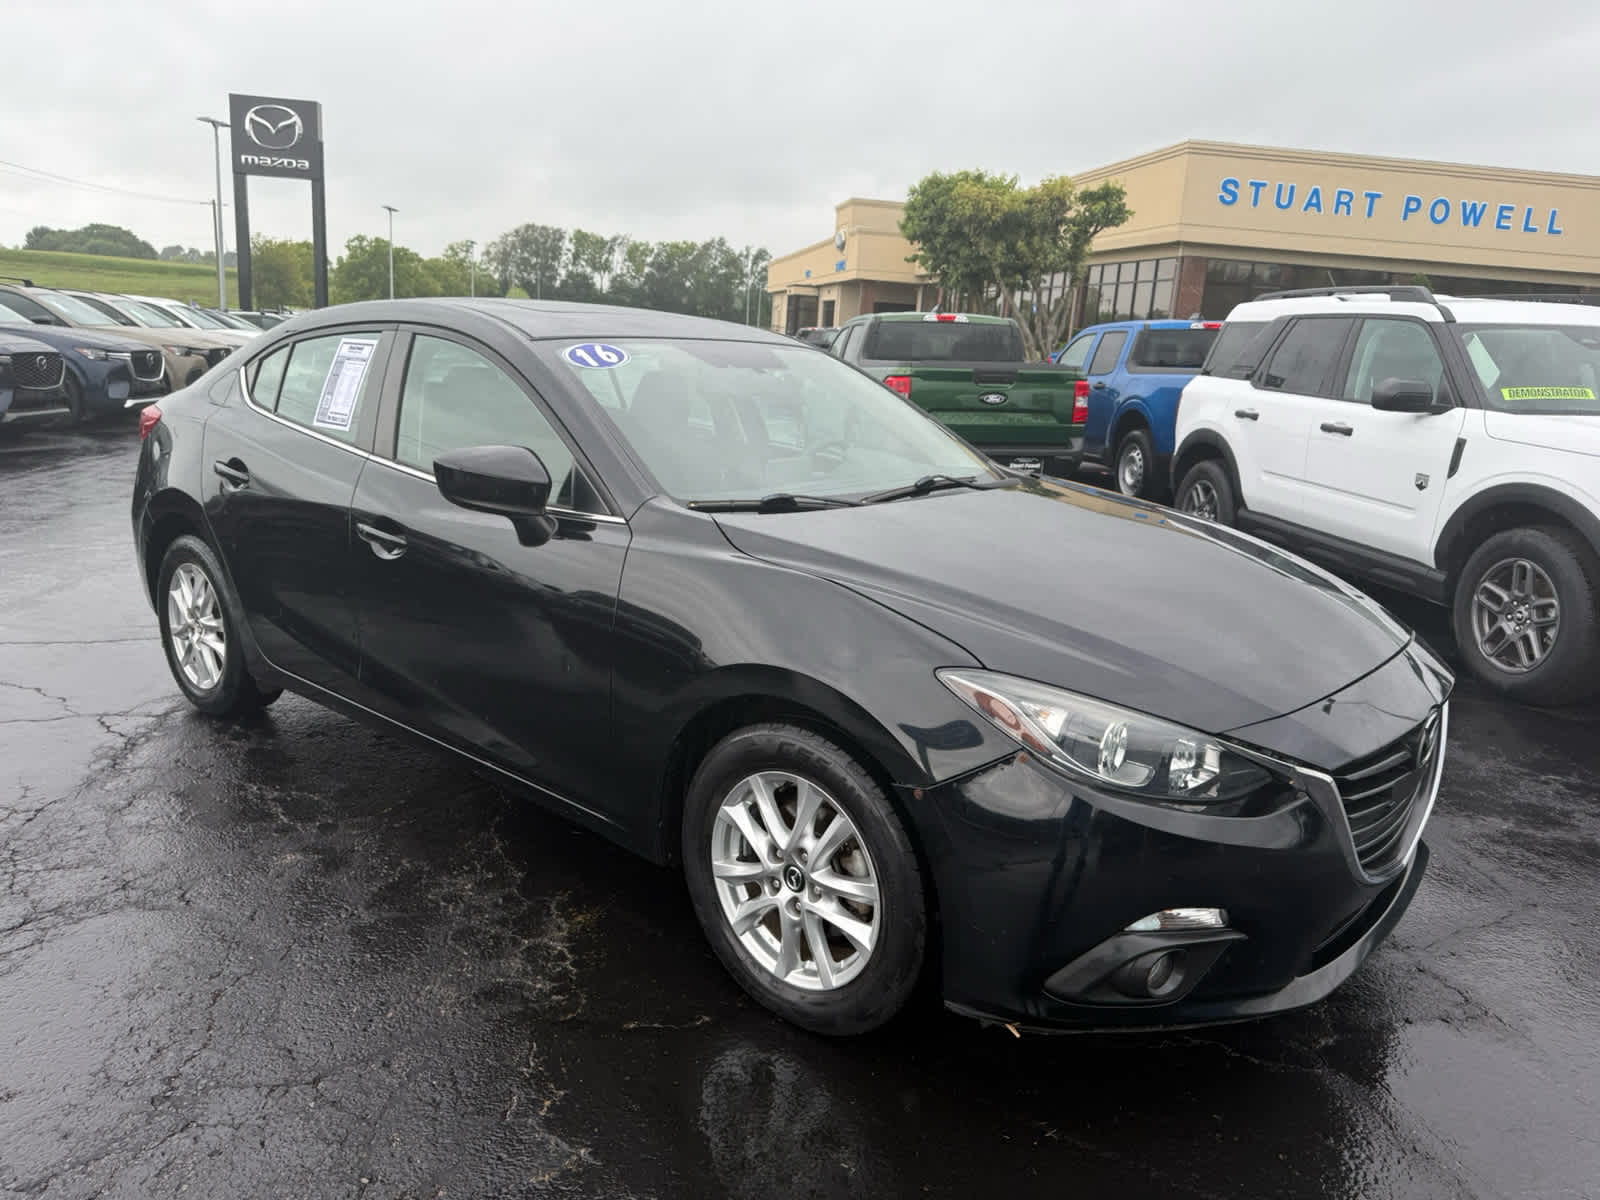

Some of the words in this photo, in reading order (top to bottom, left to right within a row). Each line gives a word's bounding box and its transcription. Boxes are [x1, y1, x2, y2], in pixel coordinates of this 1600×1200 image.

[1218, 177, 1382, 219] STUART
[1402, 195, 1563, 235] POWELL
[575, 344, 619, 367] 16
[1508, 387, 1589, 399] DEMONSTRATOR
